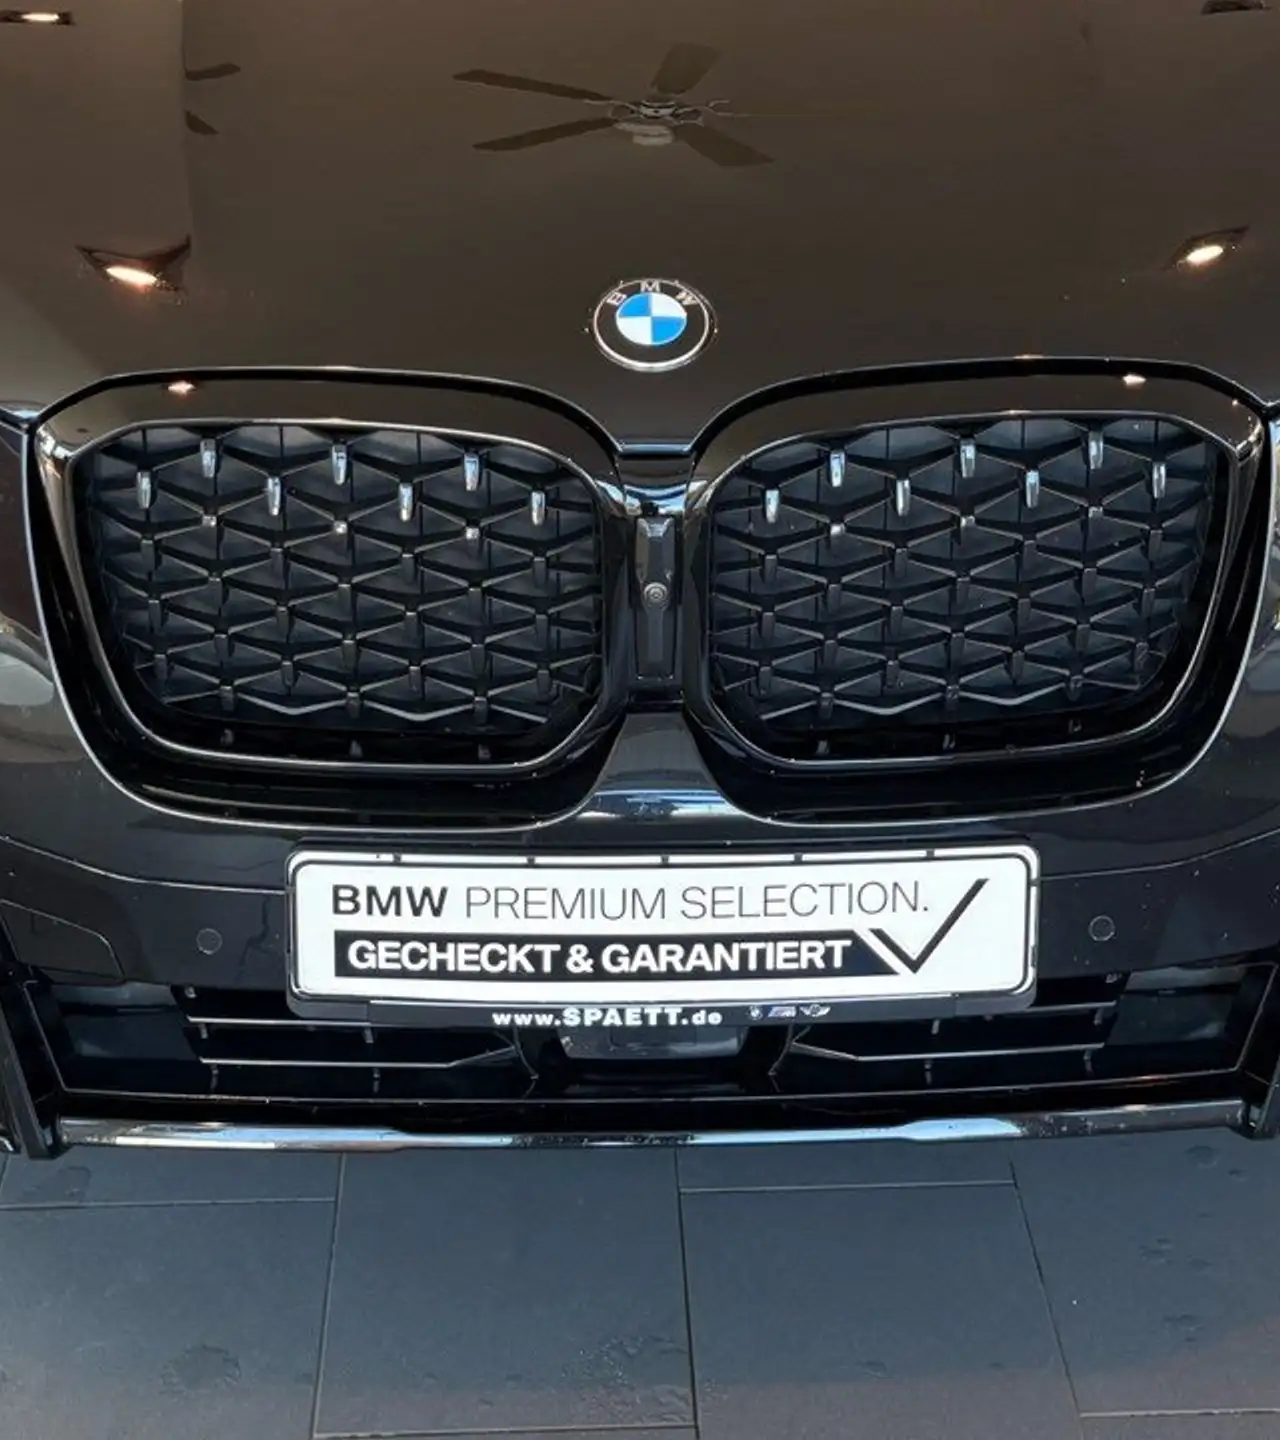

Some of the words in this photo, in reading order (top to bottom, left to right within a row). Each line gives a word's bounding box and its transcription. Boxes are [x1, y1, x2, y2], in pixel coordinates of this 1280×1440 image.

[332, 883, 449, 918] BMW
[466, 886, 666, 921] PREMIUM
[680, 880, 929, 920] SELECTION.
[347, 939, 562, 974] GECHECKT
[565, 942, 595, 974] &
[600, 939, 853, 974] GARANTIERT
[492, 1007, 724, 1027] www.SPAETT.de
